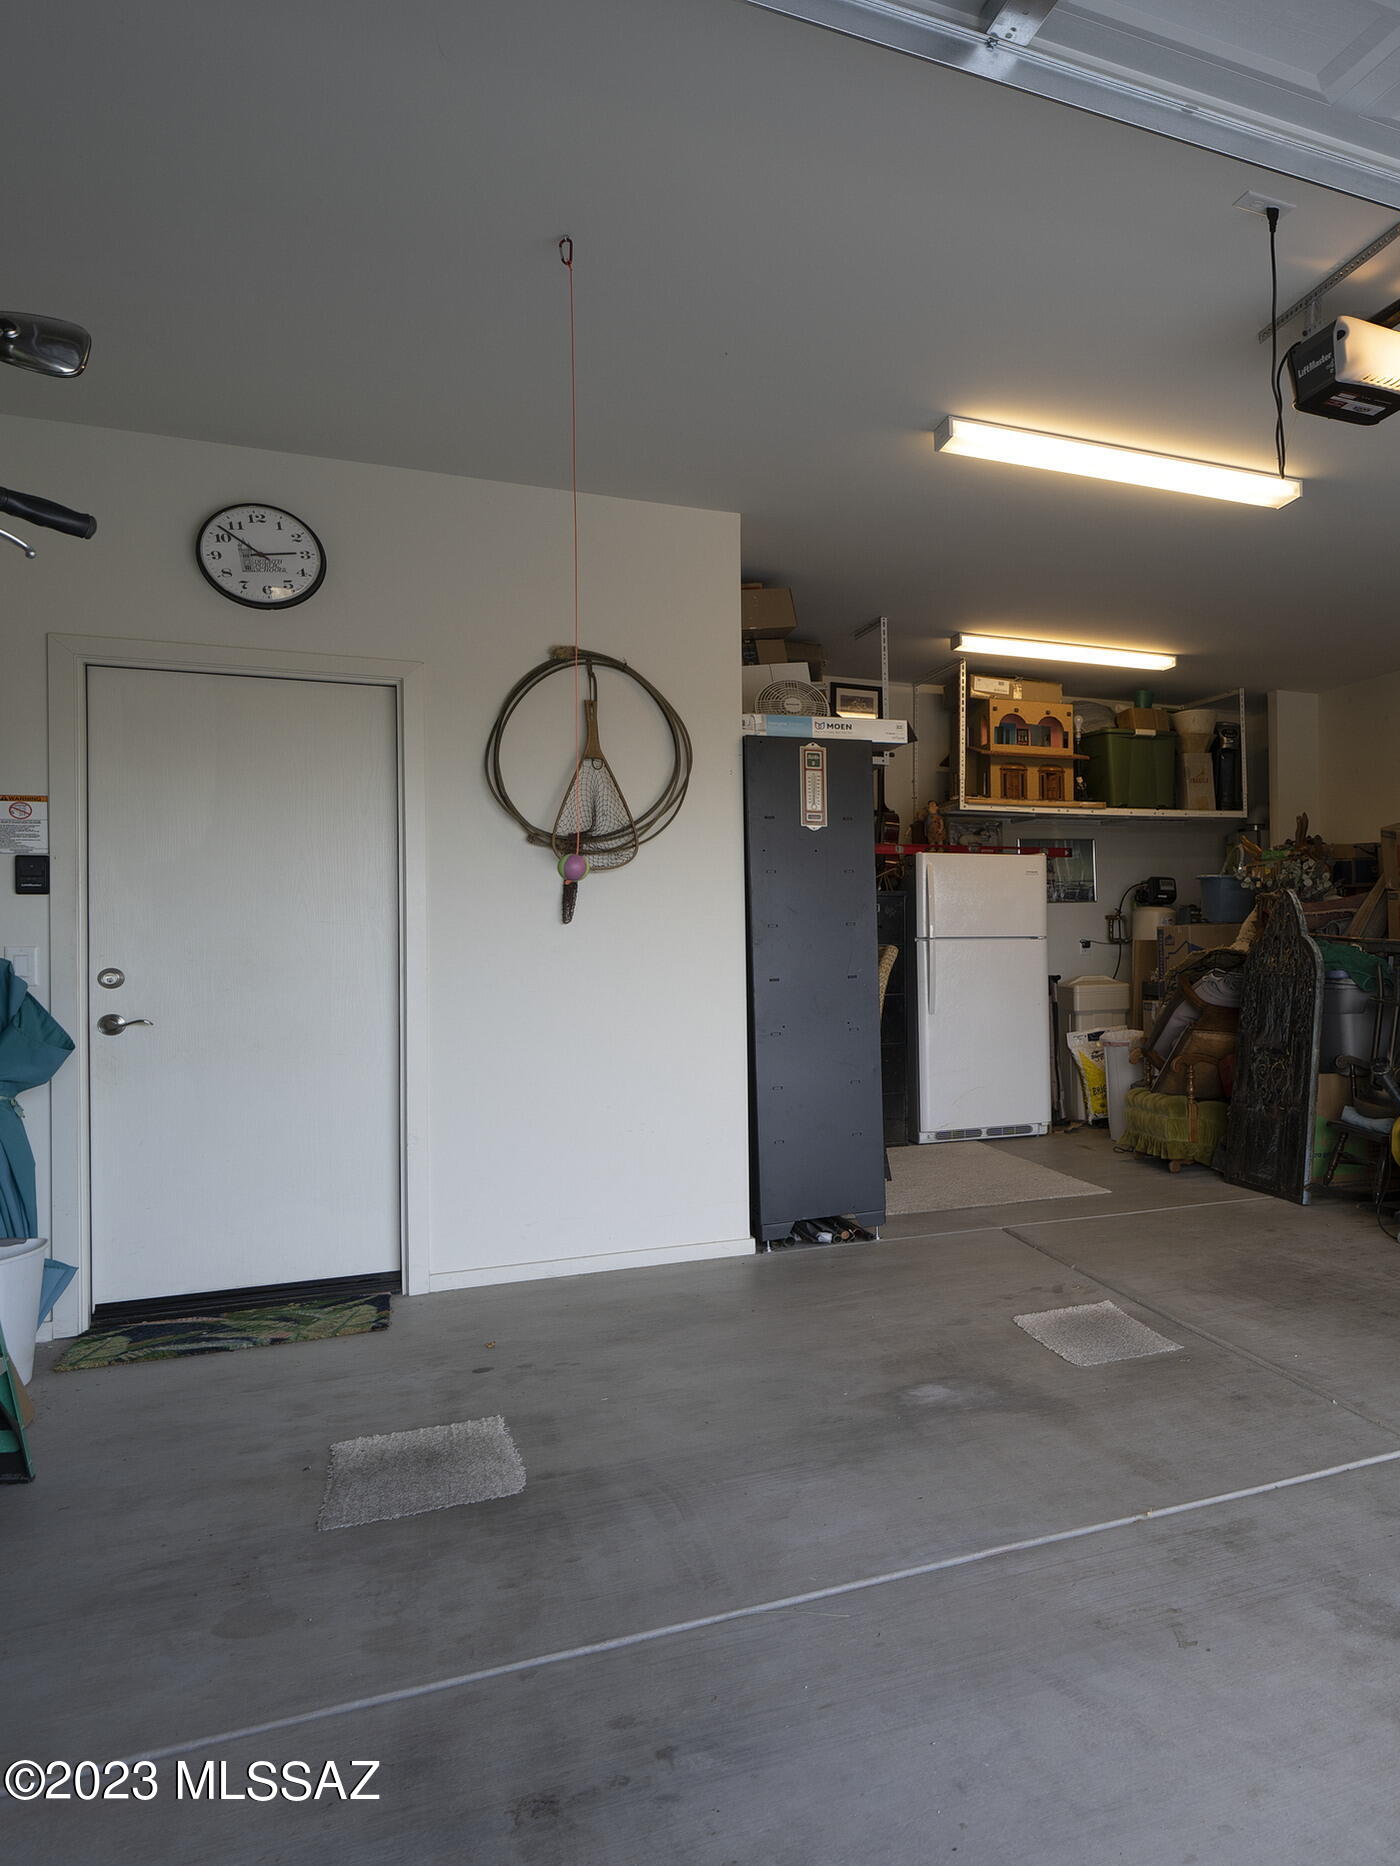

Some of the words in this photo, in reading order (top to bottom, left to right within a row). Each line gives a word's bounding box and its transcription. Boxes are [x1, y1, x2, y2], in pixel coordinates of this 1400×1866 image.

[1297, 352, 1333, 378] LiftMaster
[248, 514, 266, 524] 12
[229, 521, 244, 530] 11
[276, 521, 282, 531] 1
[215, 533, 231, 543] 10
[291, 533, 302, 543] 2
[210, 550, 222, 560] 9
[299, 550, 311, 560] 3
[221, 568, 232, 577] 8
[296, 568, 307, 577] 4
[239, 581, 248, 590] 7
[283, 580, 294, 589] 5
[262, 585, 272, 595] 6
